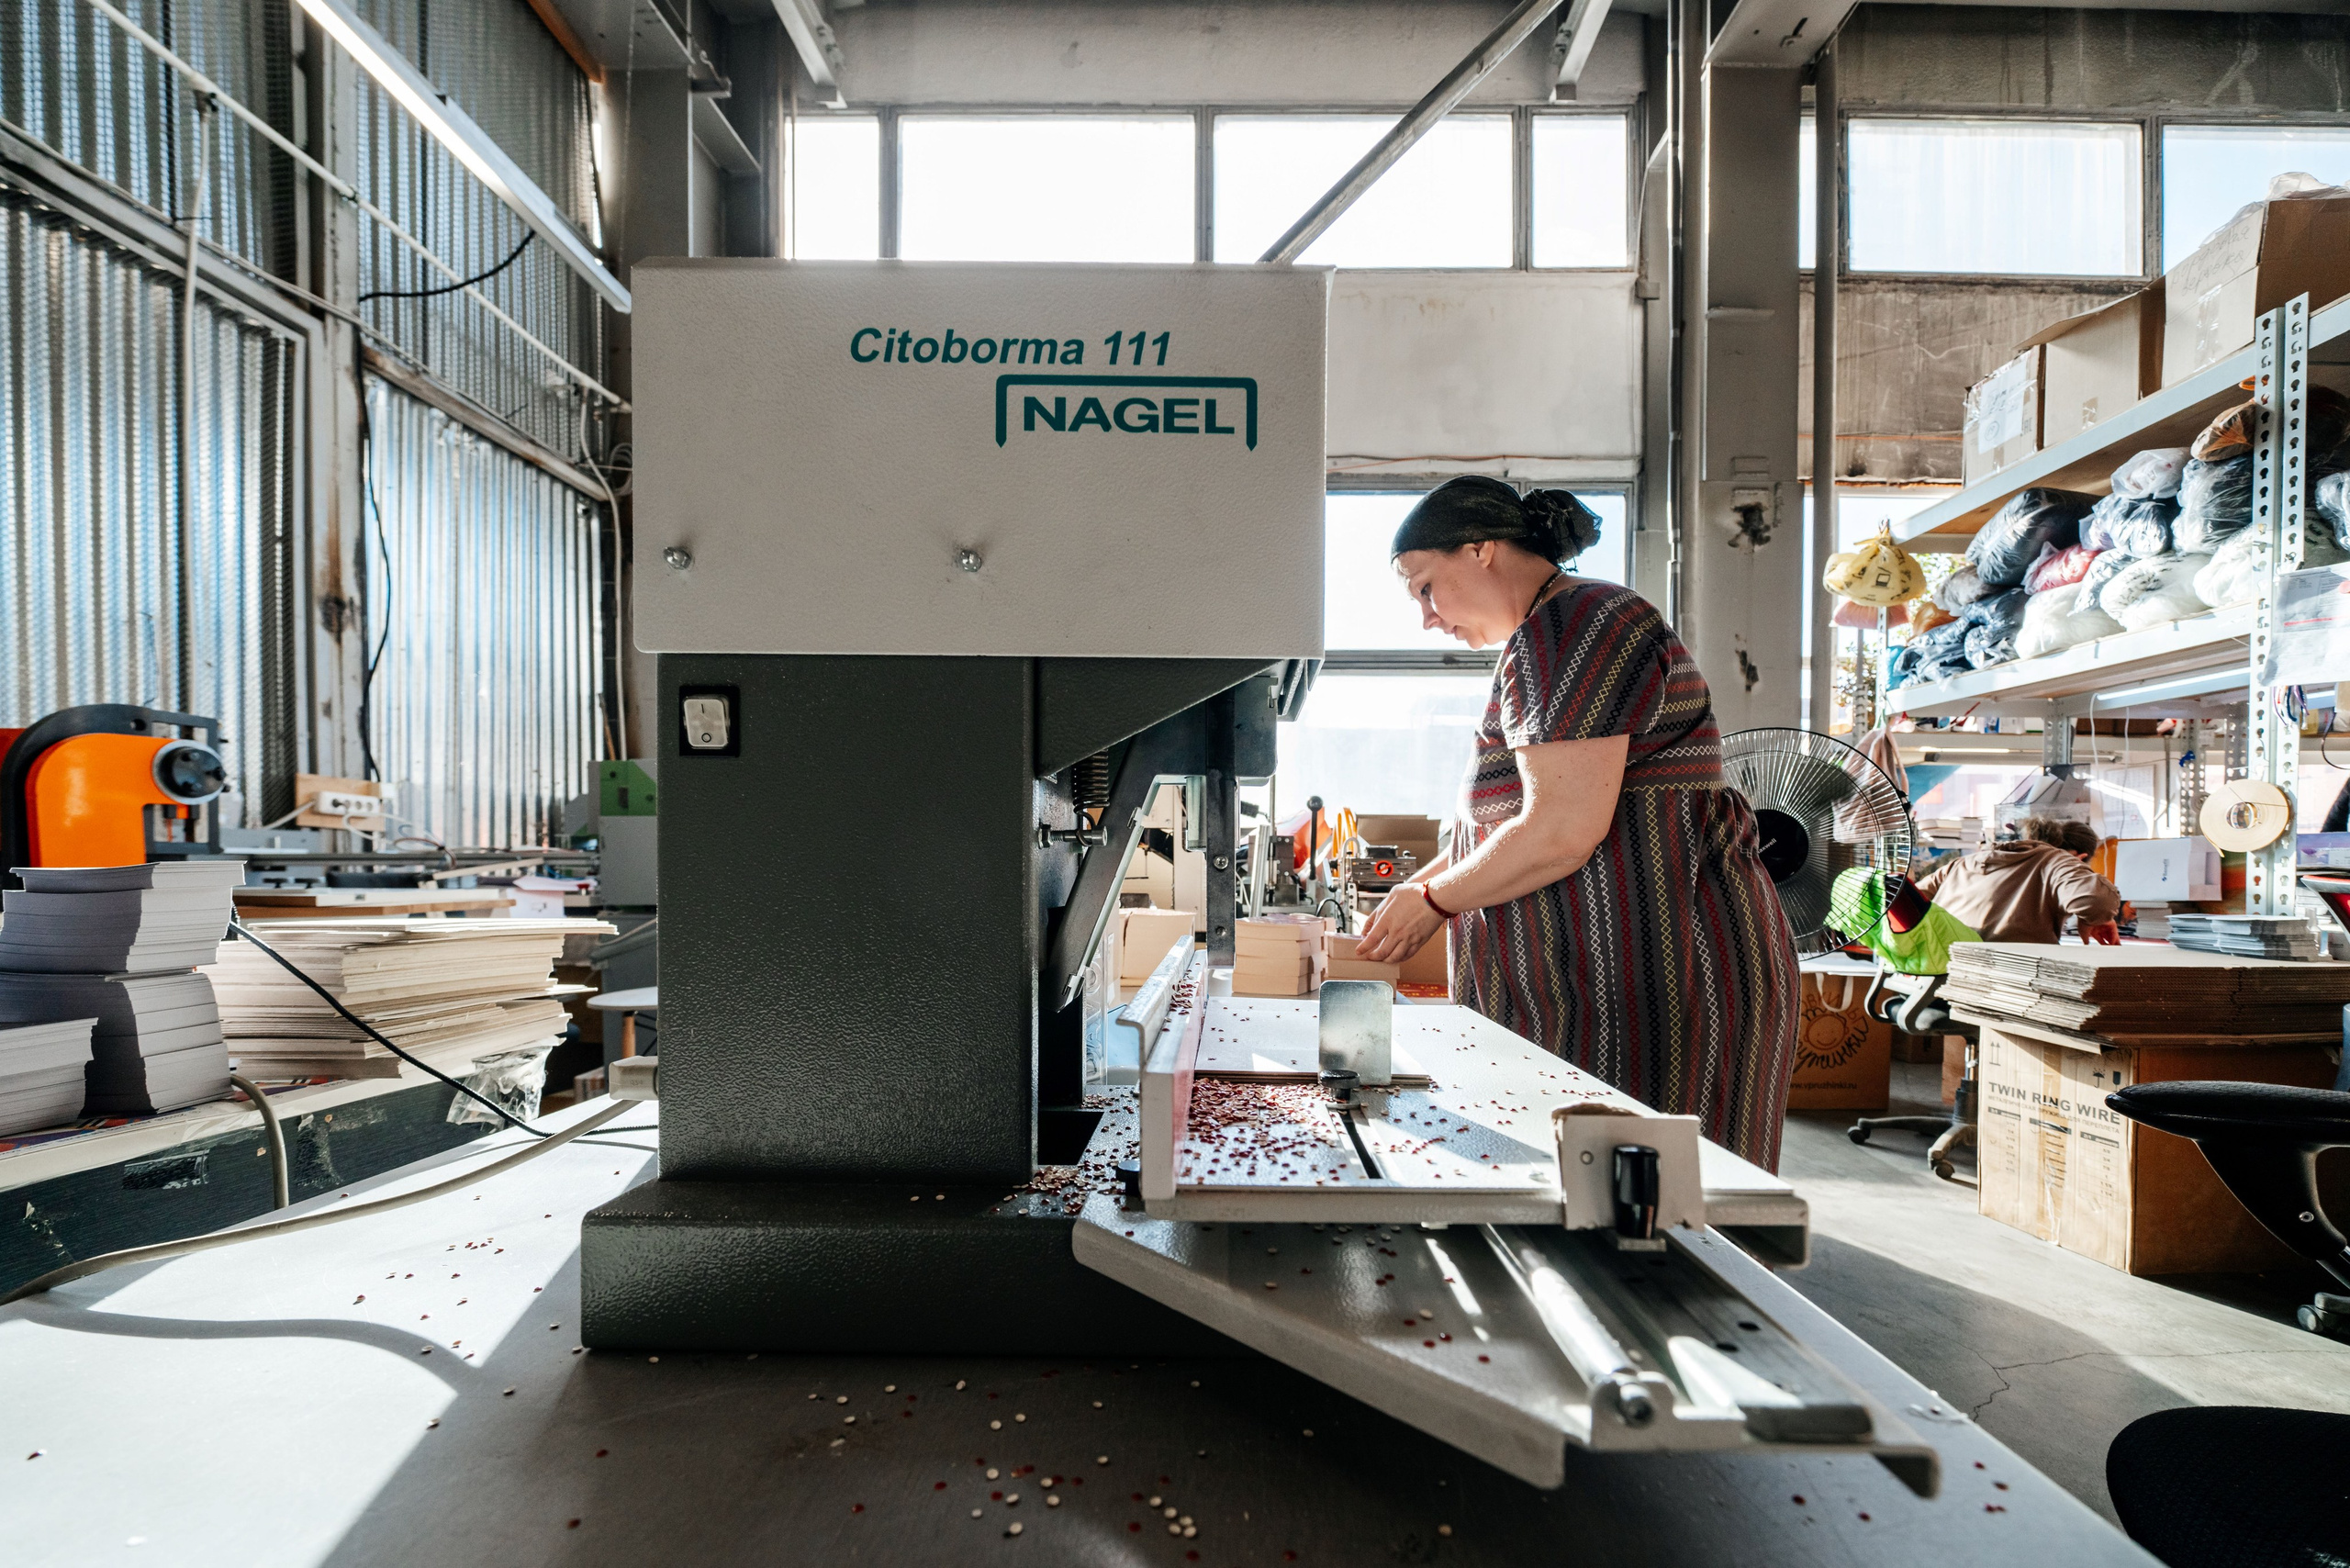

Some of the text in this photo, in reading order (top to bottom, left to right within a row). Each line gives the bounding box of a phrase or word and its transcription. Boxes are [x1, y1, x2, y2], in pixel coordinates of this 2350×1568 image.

[850, 327, 1170, 366] Citoborma 111
[1024, 396, 1235, 434] NAGEL
[1790, 1081, 1857, 1091] ww.vpruzhinki.ru
[1988, 1081, 2121, 1126] TWIN RING WIRE
